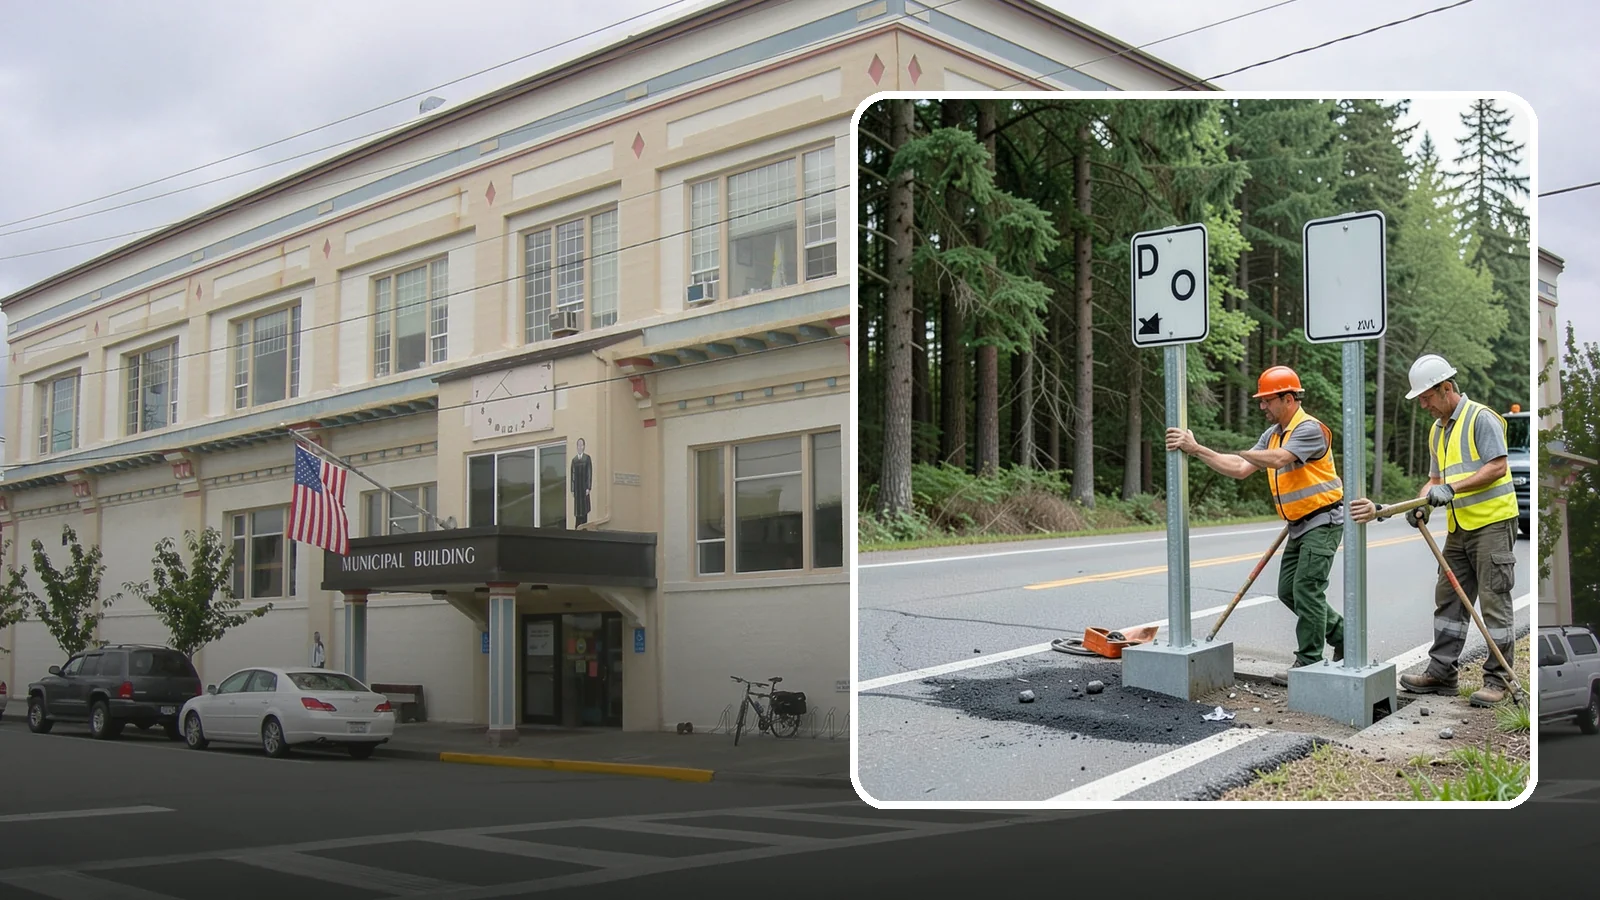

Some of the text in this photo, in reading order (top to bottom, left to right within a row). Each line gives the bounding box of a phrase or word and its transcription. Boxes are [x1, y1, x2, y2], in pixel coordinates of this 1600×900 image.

[536, 402, 540, 410] 4
[488, 418, 492, 426] 9
[529, 414, 533, 422] 3
[342, 546, 475, 572] MUNICIPAL BUILDING
